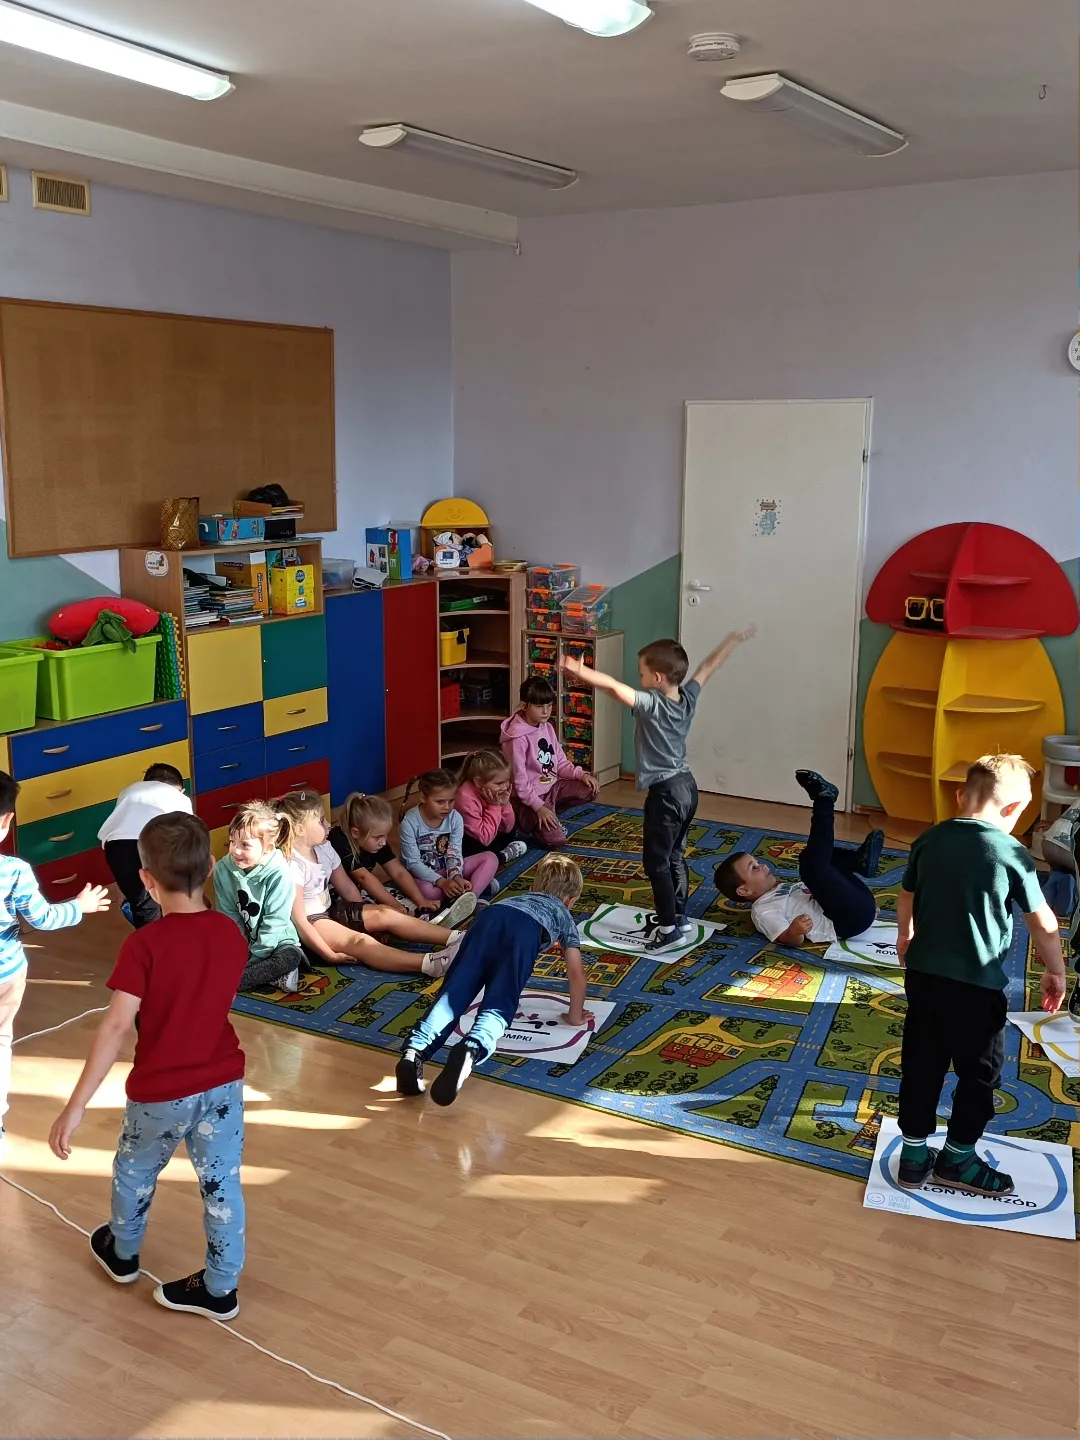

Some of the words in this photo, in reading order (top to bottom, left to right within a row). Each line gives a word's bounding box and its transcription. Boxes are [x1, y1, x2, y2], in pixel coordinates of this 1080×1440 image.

[611, 935, 647, 946] PAJACYK
[502, 1033, 533, 1042] MPKI
[982, 1194, 1038, 1208] PRZÓD
